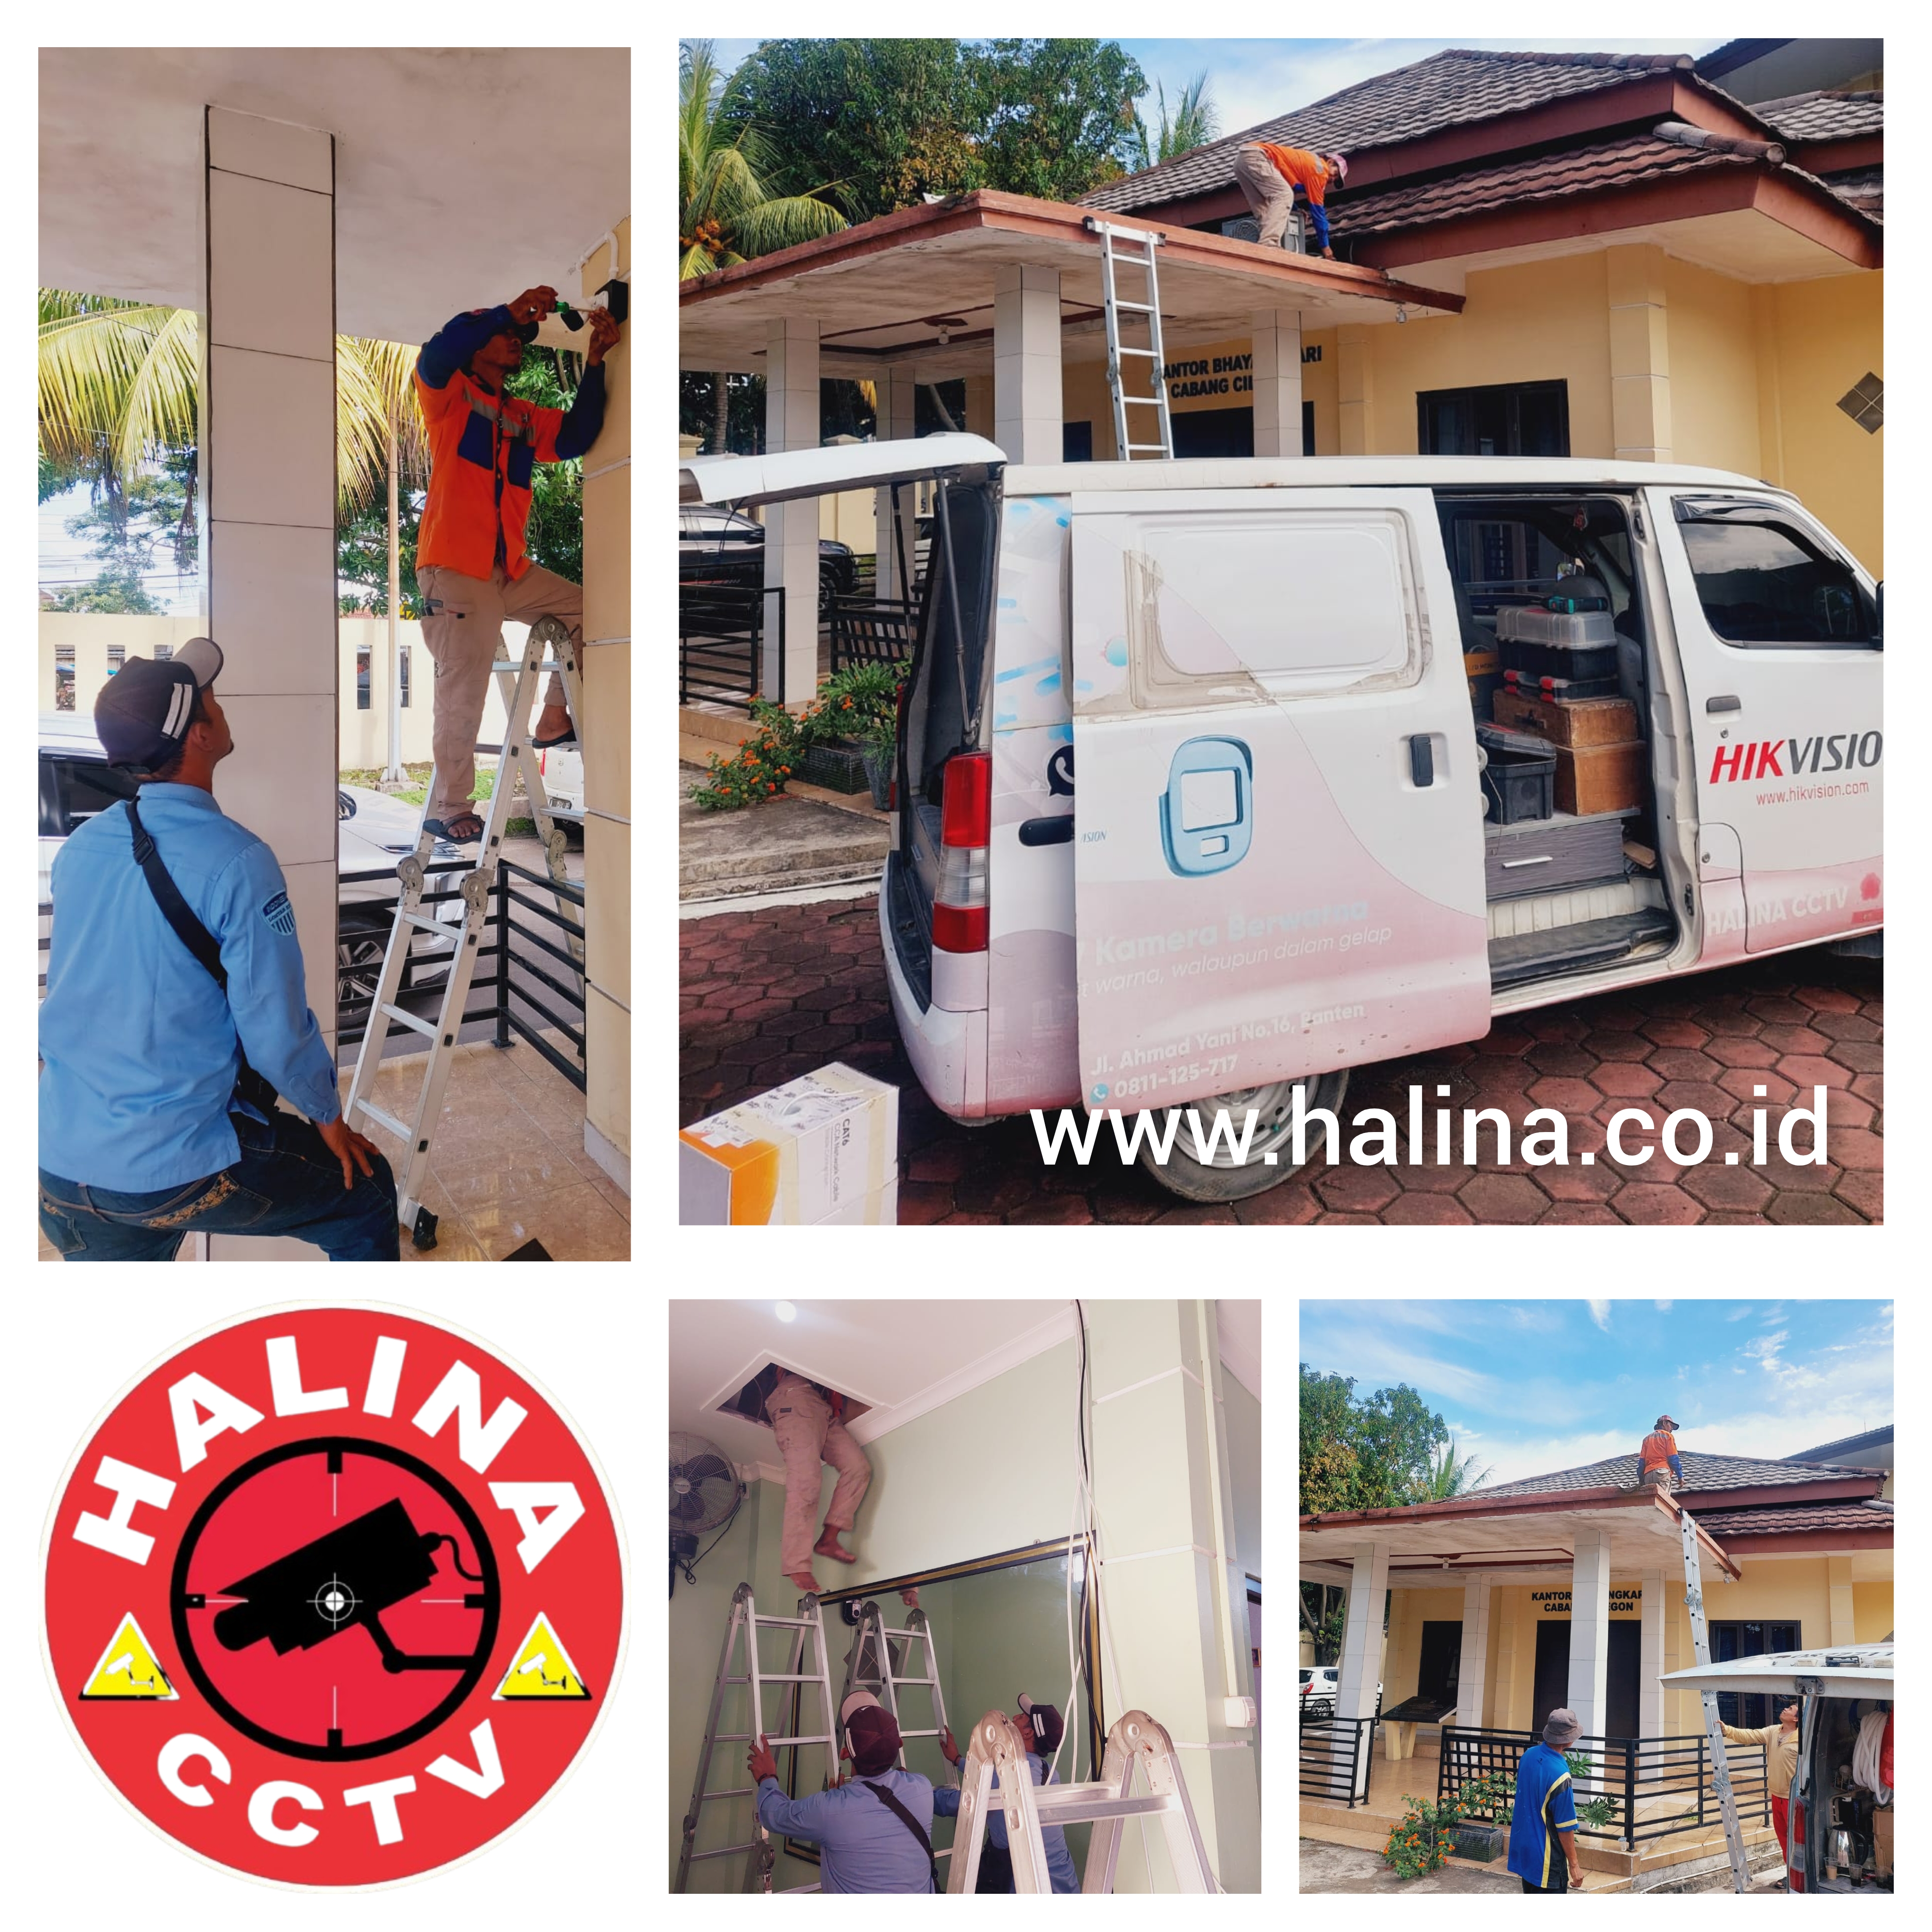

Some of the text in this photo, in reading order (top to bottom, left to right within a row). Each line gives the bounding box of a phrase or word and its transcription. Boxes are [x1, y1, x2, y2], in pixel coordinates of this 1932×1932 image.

[1164, 360, 1209, 379] ANTOR
[1171, 378, 1229, 398] CABANG
[1709, 730, 1883, 784] HIKVISIO
[1756, 781, 1870, 805] www.hikvision.com
[1096, 924, 1217, 966] Kamera
[1228, 901, 1369, 941] Berwarna
[1706, 886, 1849, 937] HALINA CCTV
[1095, 968, 1164, 993] warna,
[1172, 948, 1268, 977] walaupun
[1274, 935, 1334, 960] dalam
[1339, 926, 1392, 953] gelap
[1120, 1040, 1190, 1070] Ahmad
[1196, 1027, 1237, 1051] Yani
[1241, 1017, 1295, 1043] No.16,
[1300, 1004, 1365, 1029] Banten
[1114, 1054, 1240, 1098] 0811-125-717
[842, 1118, 850, 1146] CAT6
[1532, 1592, 1572, 1600] KANTOR
